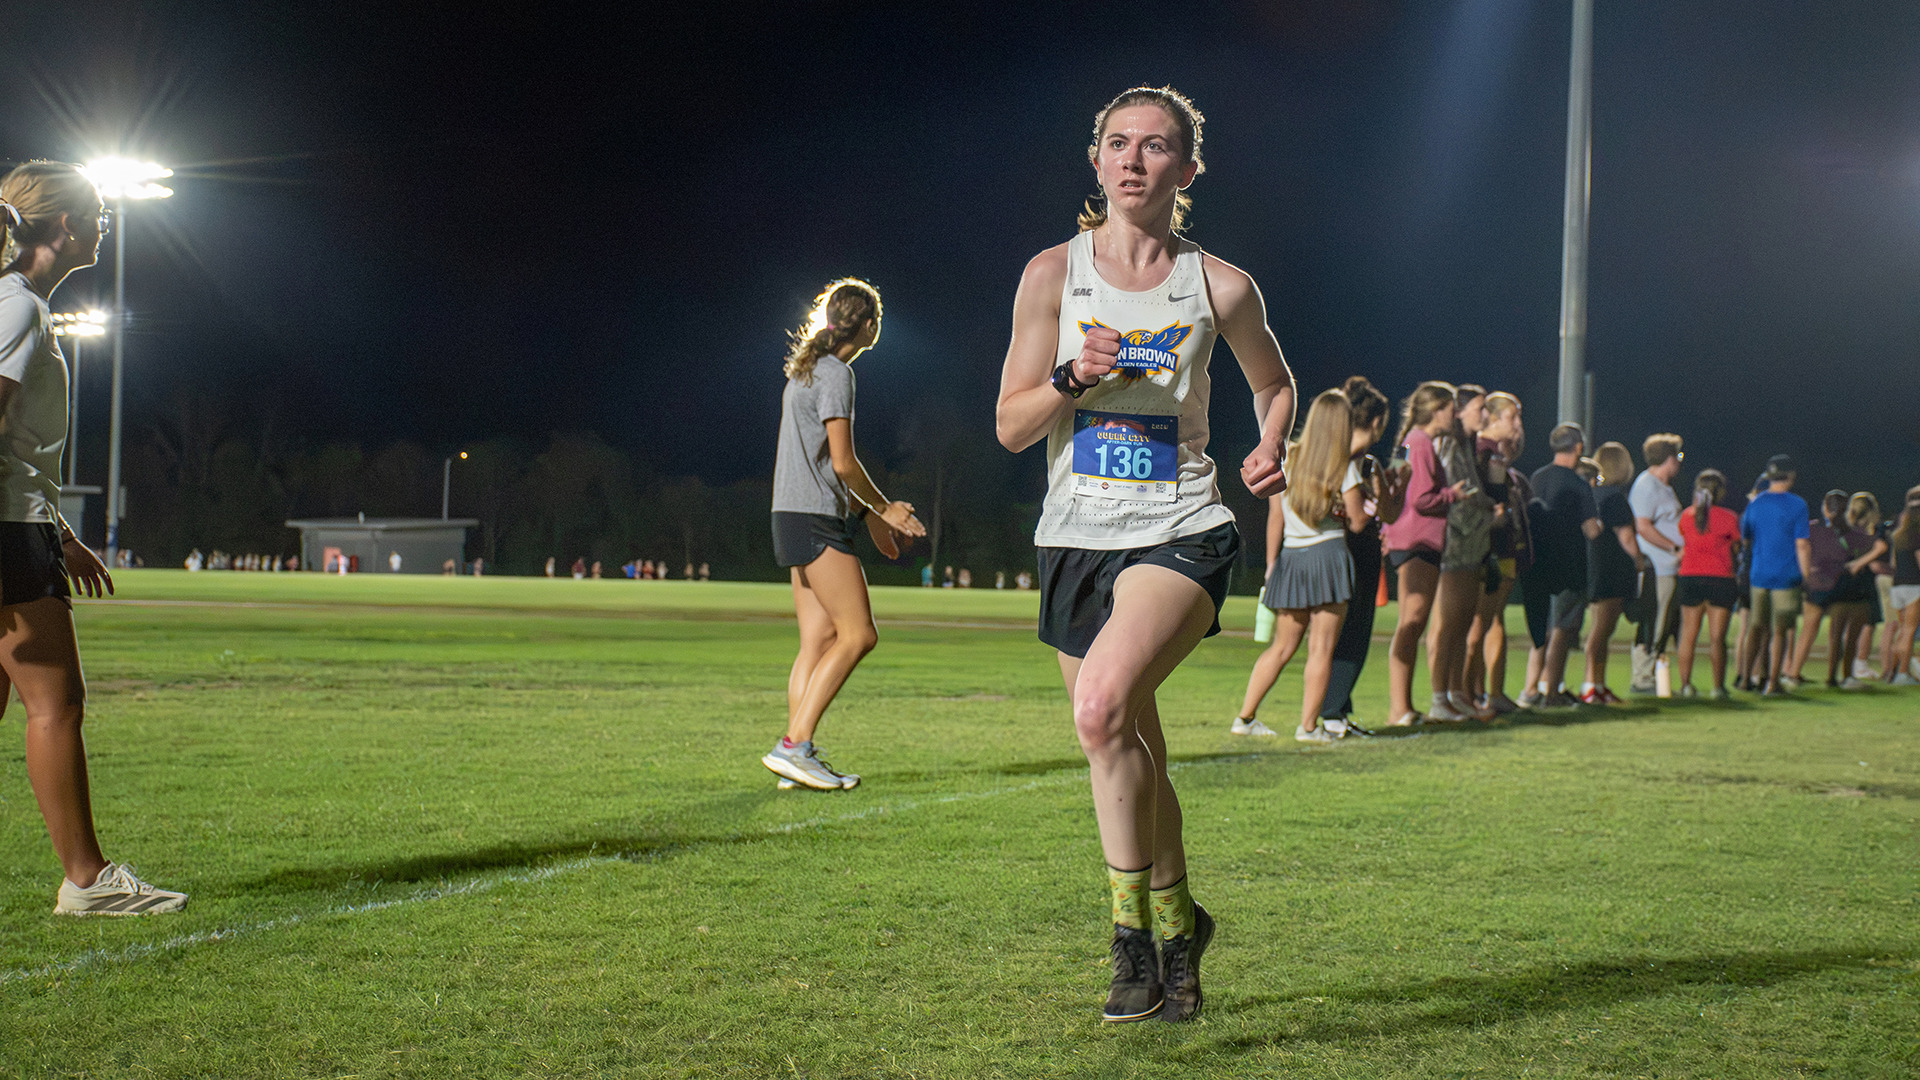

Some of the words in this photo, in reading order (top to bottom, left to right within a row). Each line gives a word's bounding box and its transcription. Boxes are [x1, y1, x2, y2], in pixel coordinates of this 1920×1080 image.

[1128, 347, 1176, 369] BROWN
[1097, 431, 1126, 441] QUEEN
[1095, 444, 1152, 479] 136
